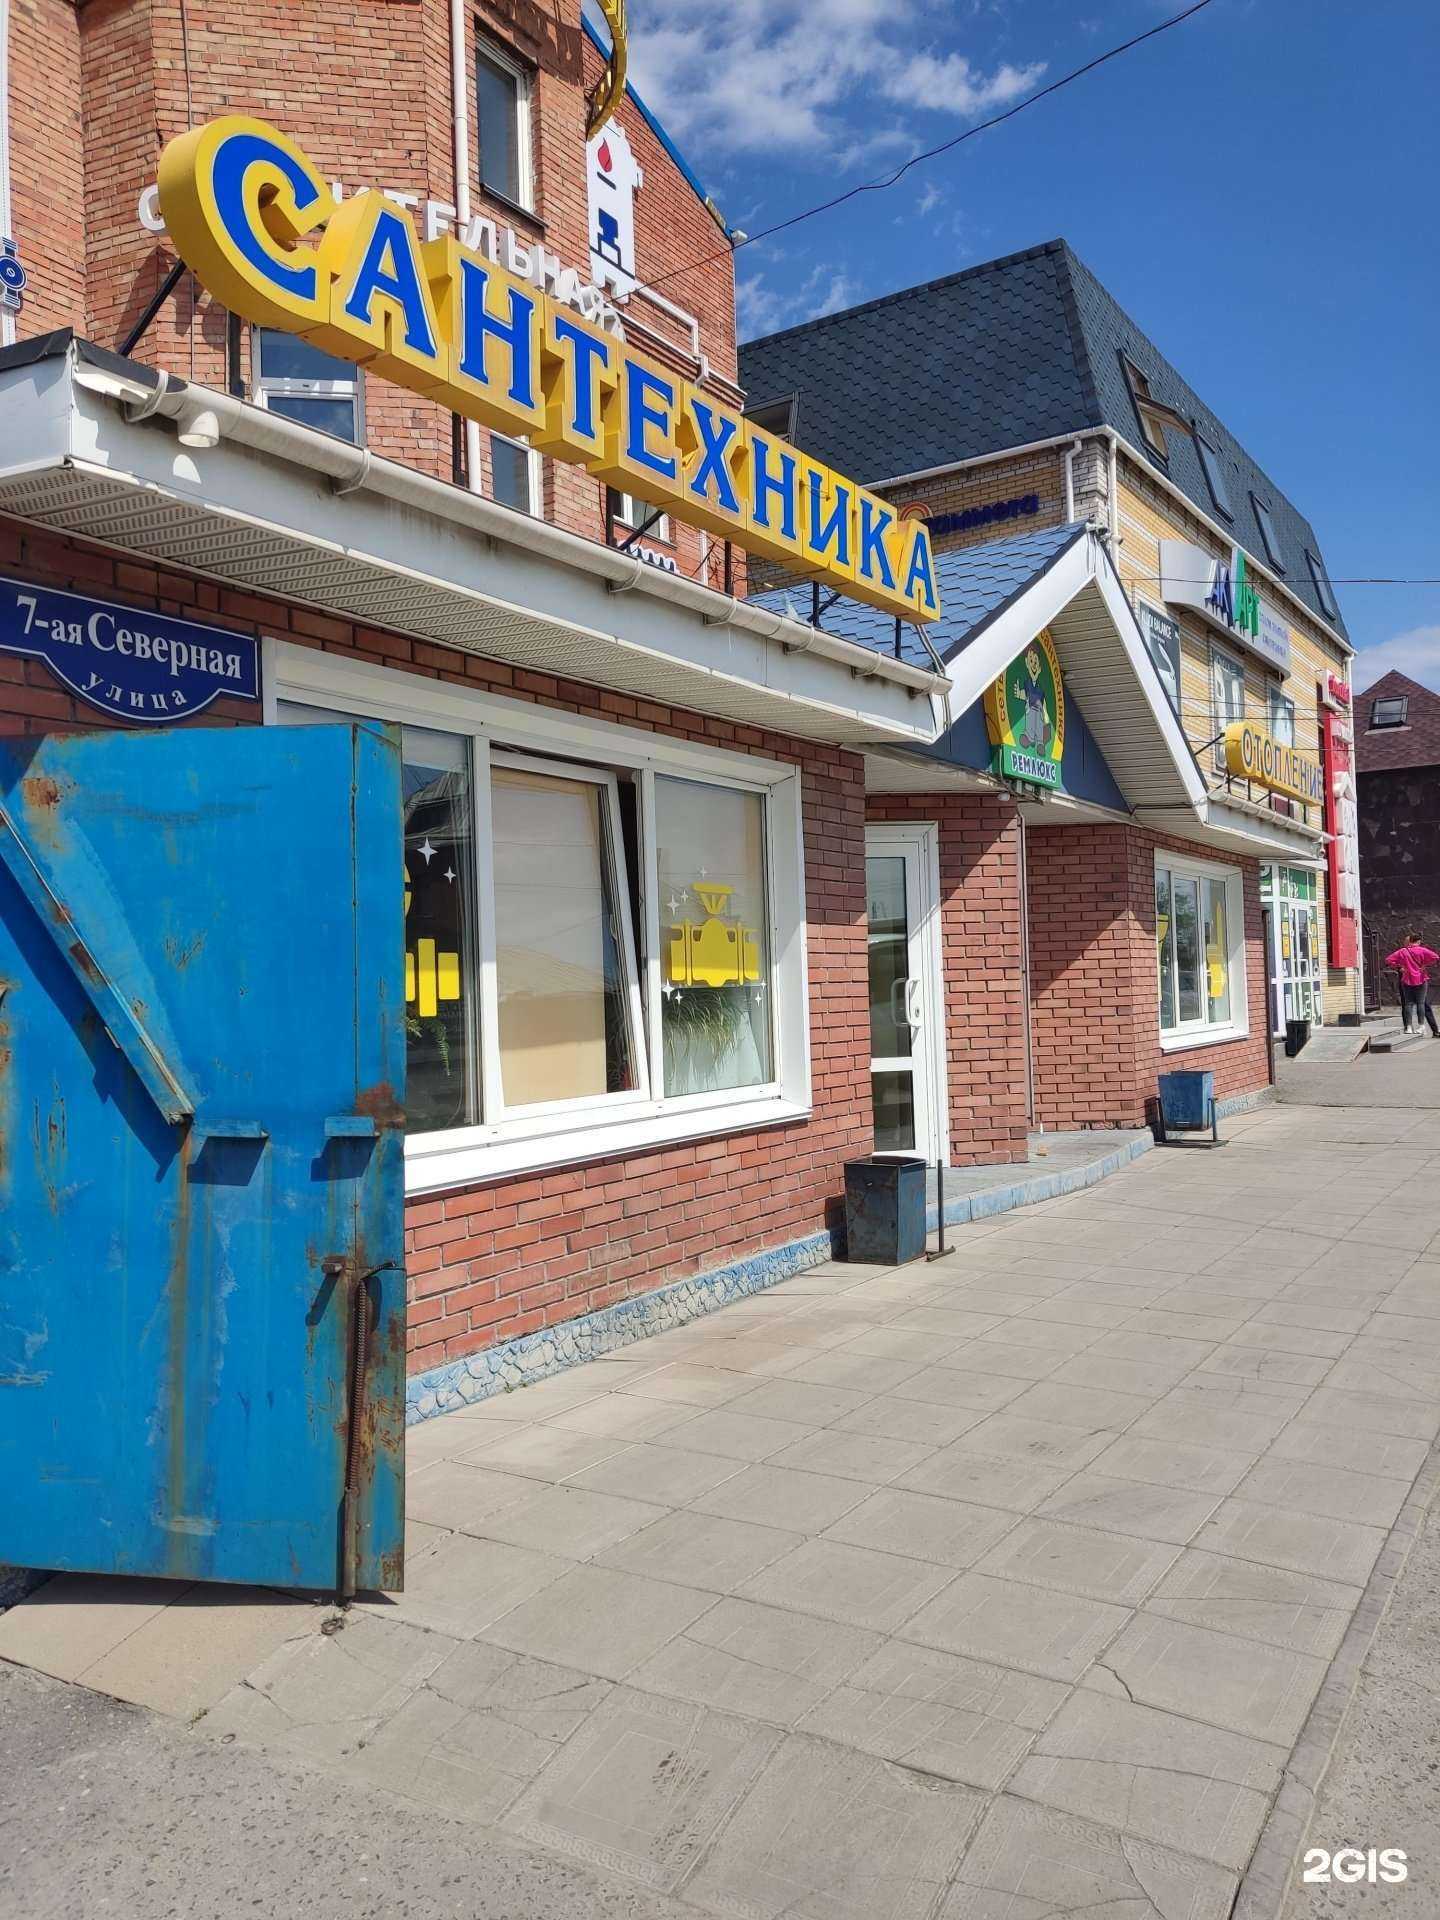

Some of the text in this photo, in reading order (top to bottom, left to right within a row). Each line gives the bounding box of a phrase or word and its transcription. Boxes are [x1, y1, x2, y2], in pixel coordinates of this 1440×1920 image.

[211, 134, 938, 611] САНТЕХНИКА
[16, 595, 242, 679] 7-ая Северная
[81, 671, 187, 711] улица
[1011, 751, 1057, 783] РЕМЛЮКС
[1242, 728, 1323, 803] ОТОПЛЕНИЕ
